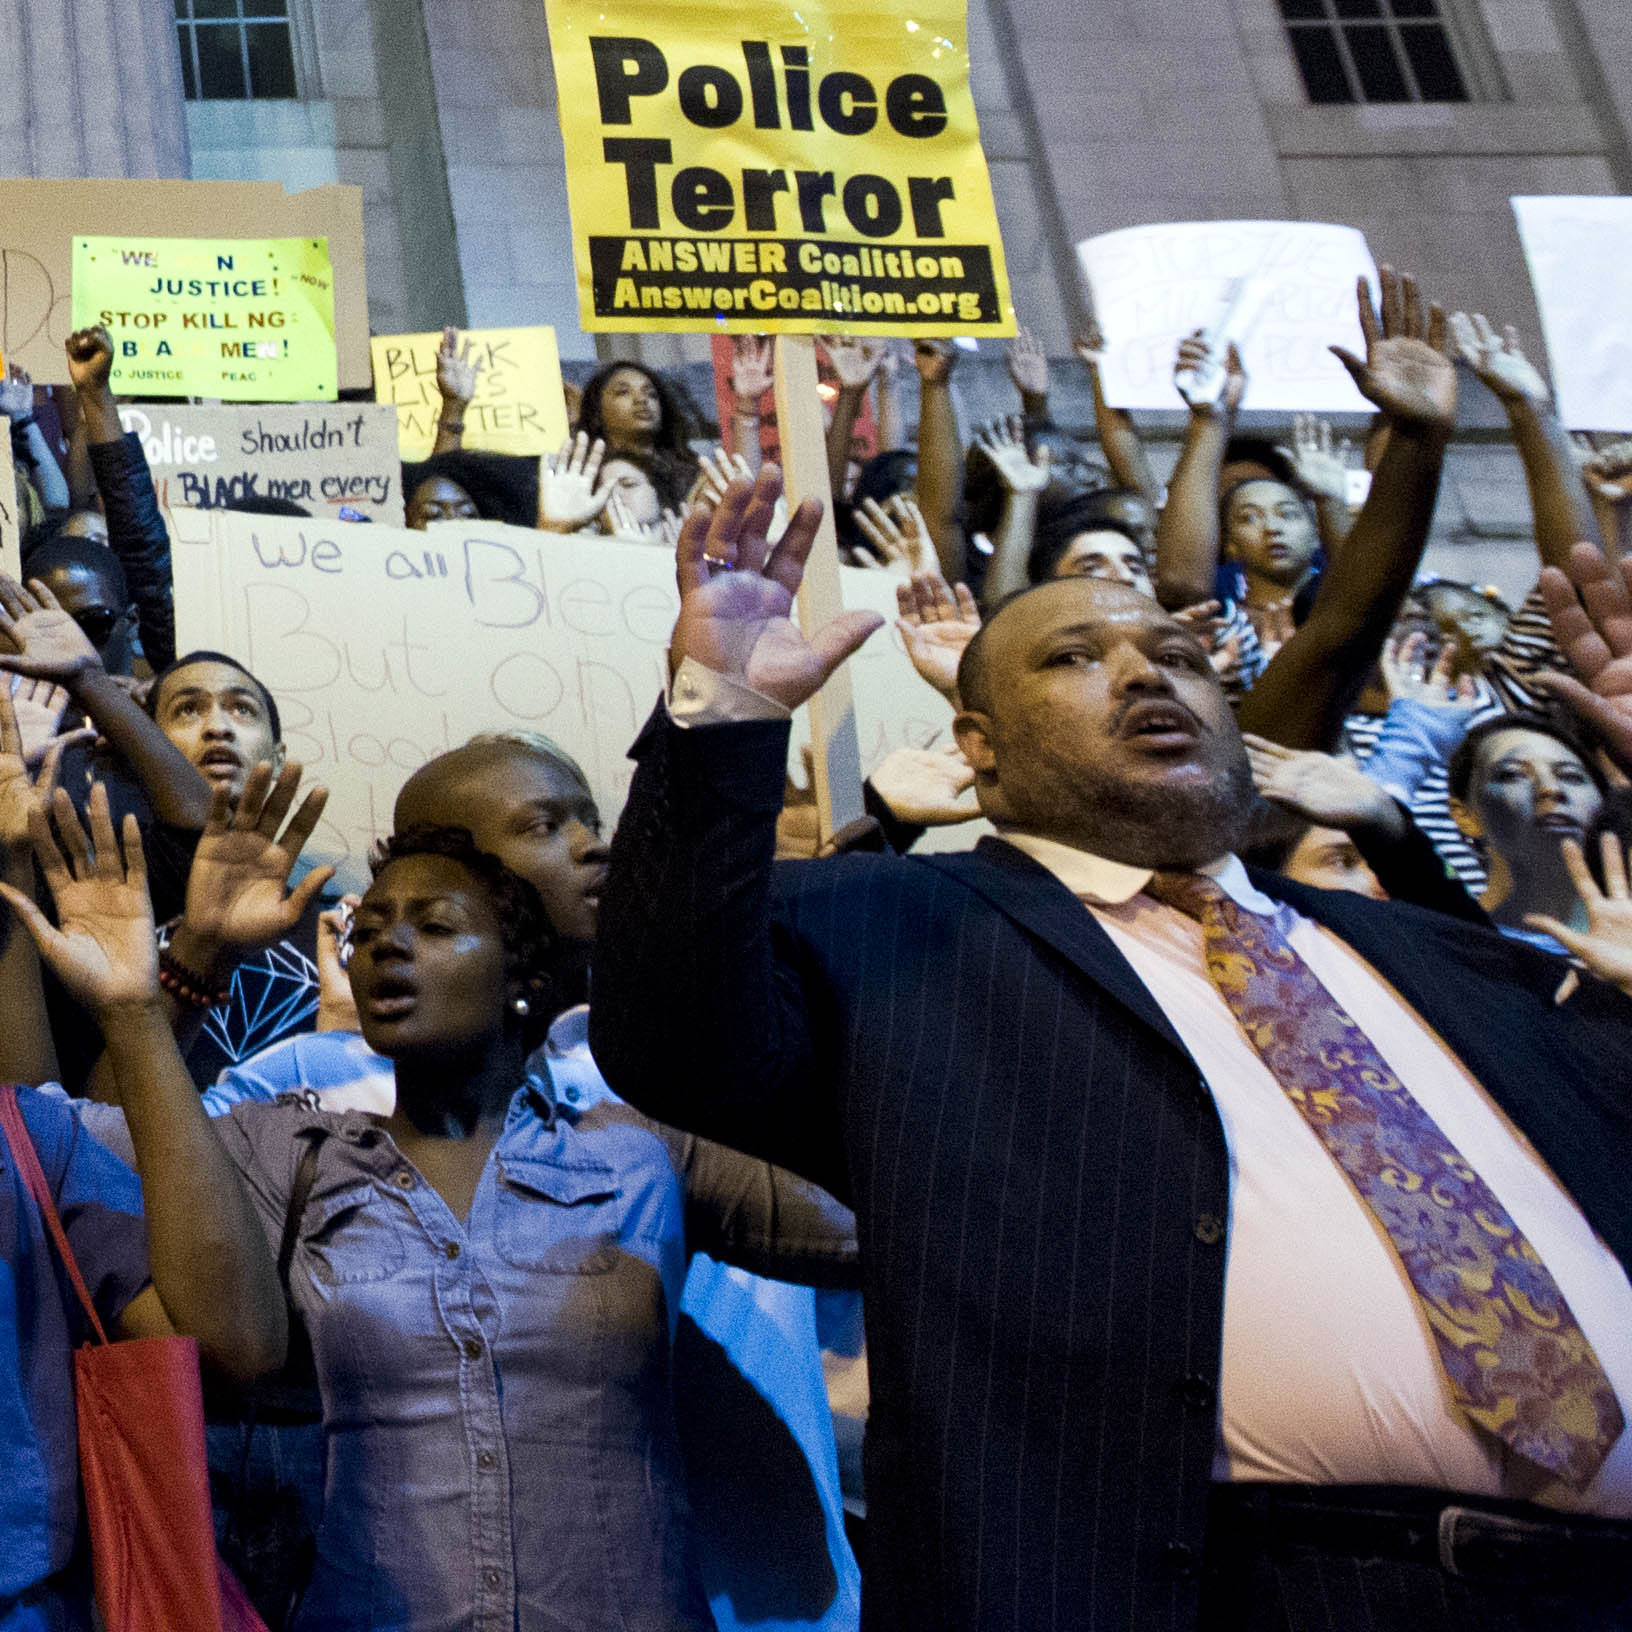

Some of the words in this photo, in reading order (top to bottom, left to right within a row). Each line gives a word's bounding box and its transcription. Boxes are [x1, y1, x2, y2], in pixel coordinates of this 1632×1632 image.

[589, 35, 947, 139] Police
[603, 137, 955, 239] Terror
[620, 240, 788, 274] ANSWER
[799, 241, 965, 280] Coalition
[149, 277, 280, 298] JUSTICE!
[614, 279, 982, 322] AnswerCoalition.org
[98, 310, 168, 330] STOP
[183, 310, 286, 330] KILLNG
[128, 369, 184, 381] JUSTICE
[386, 340, 519, 381] BLK
[391, 371, 507, 407] LIS
[240, 415, 365, 456] shouldn't
[177, 472, 259, 510] BLACK
[267, 479, 311, 501] men
[320, 474, 391, 505] every
[252, 532, 343, 573] We
[385, 550, 448, 581] all
[463, 538, 675, 643] Blee
[244, 581, 447, 698] But
